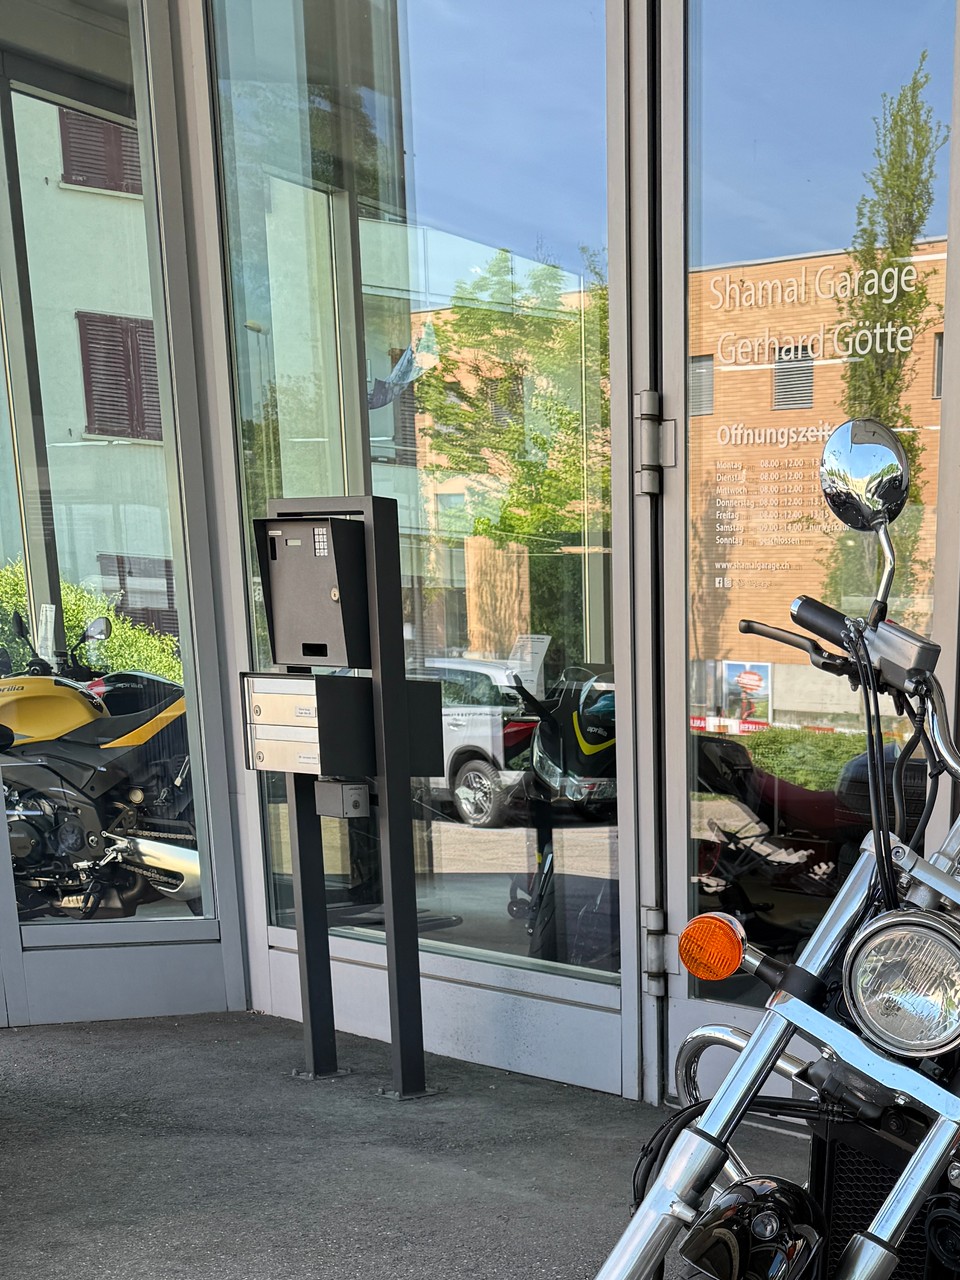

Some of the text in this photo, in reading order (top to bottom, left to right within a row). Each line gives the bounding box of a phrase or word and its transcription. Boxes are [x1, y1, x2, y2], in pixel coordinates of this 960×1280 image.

[709, 264, 918, 311] Shamal Garage
[717, 321, 914, 365] Gerhard Götte
